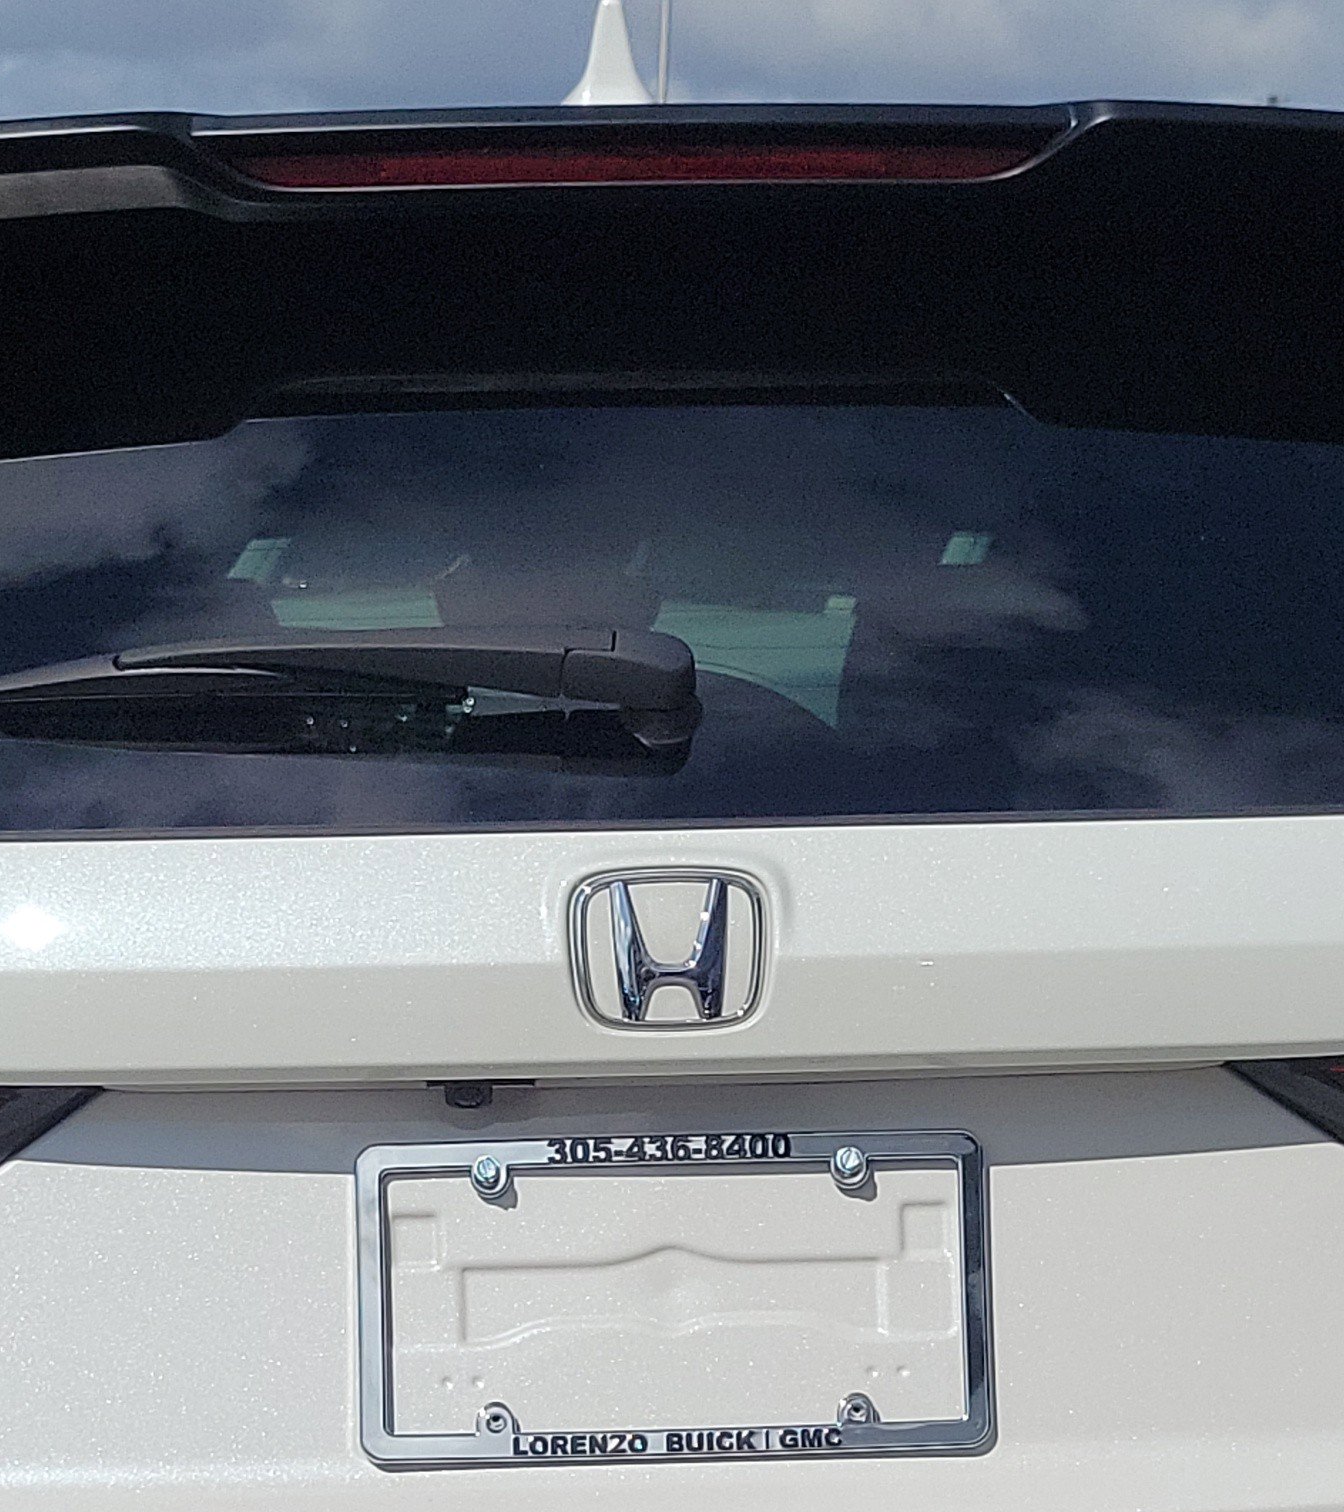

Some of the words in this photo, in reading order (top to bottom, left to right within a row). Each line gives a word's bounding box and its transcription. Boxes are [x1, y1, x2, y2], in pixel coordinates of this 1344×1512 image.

[546, 1133, 792, 1164] 305-436-8400
[512, 1433, 648, 1457] LORENZO
[666, 1429, 756, 1453] BUICK
[778, 1427, 844, 1451] GMC
